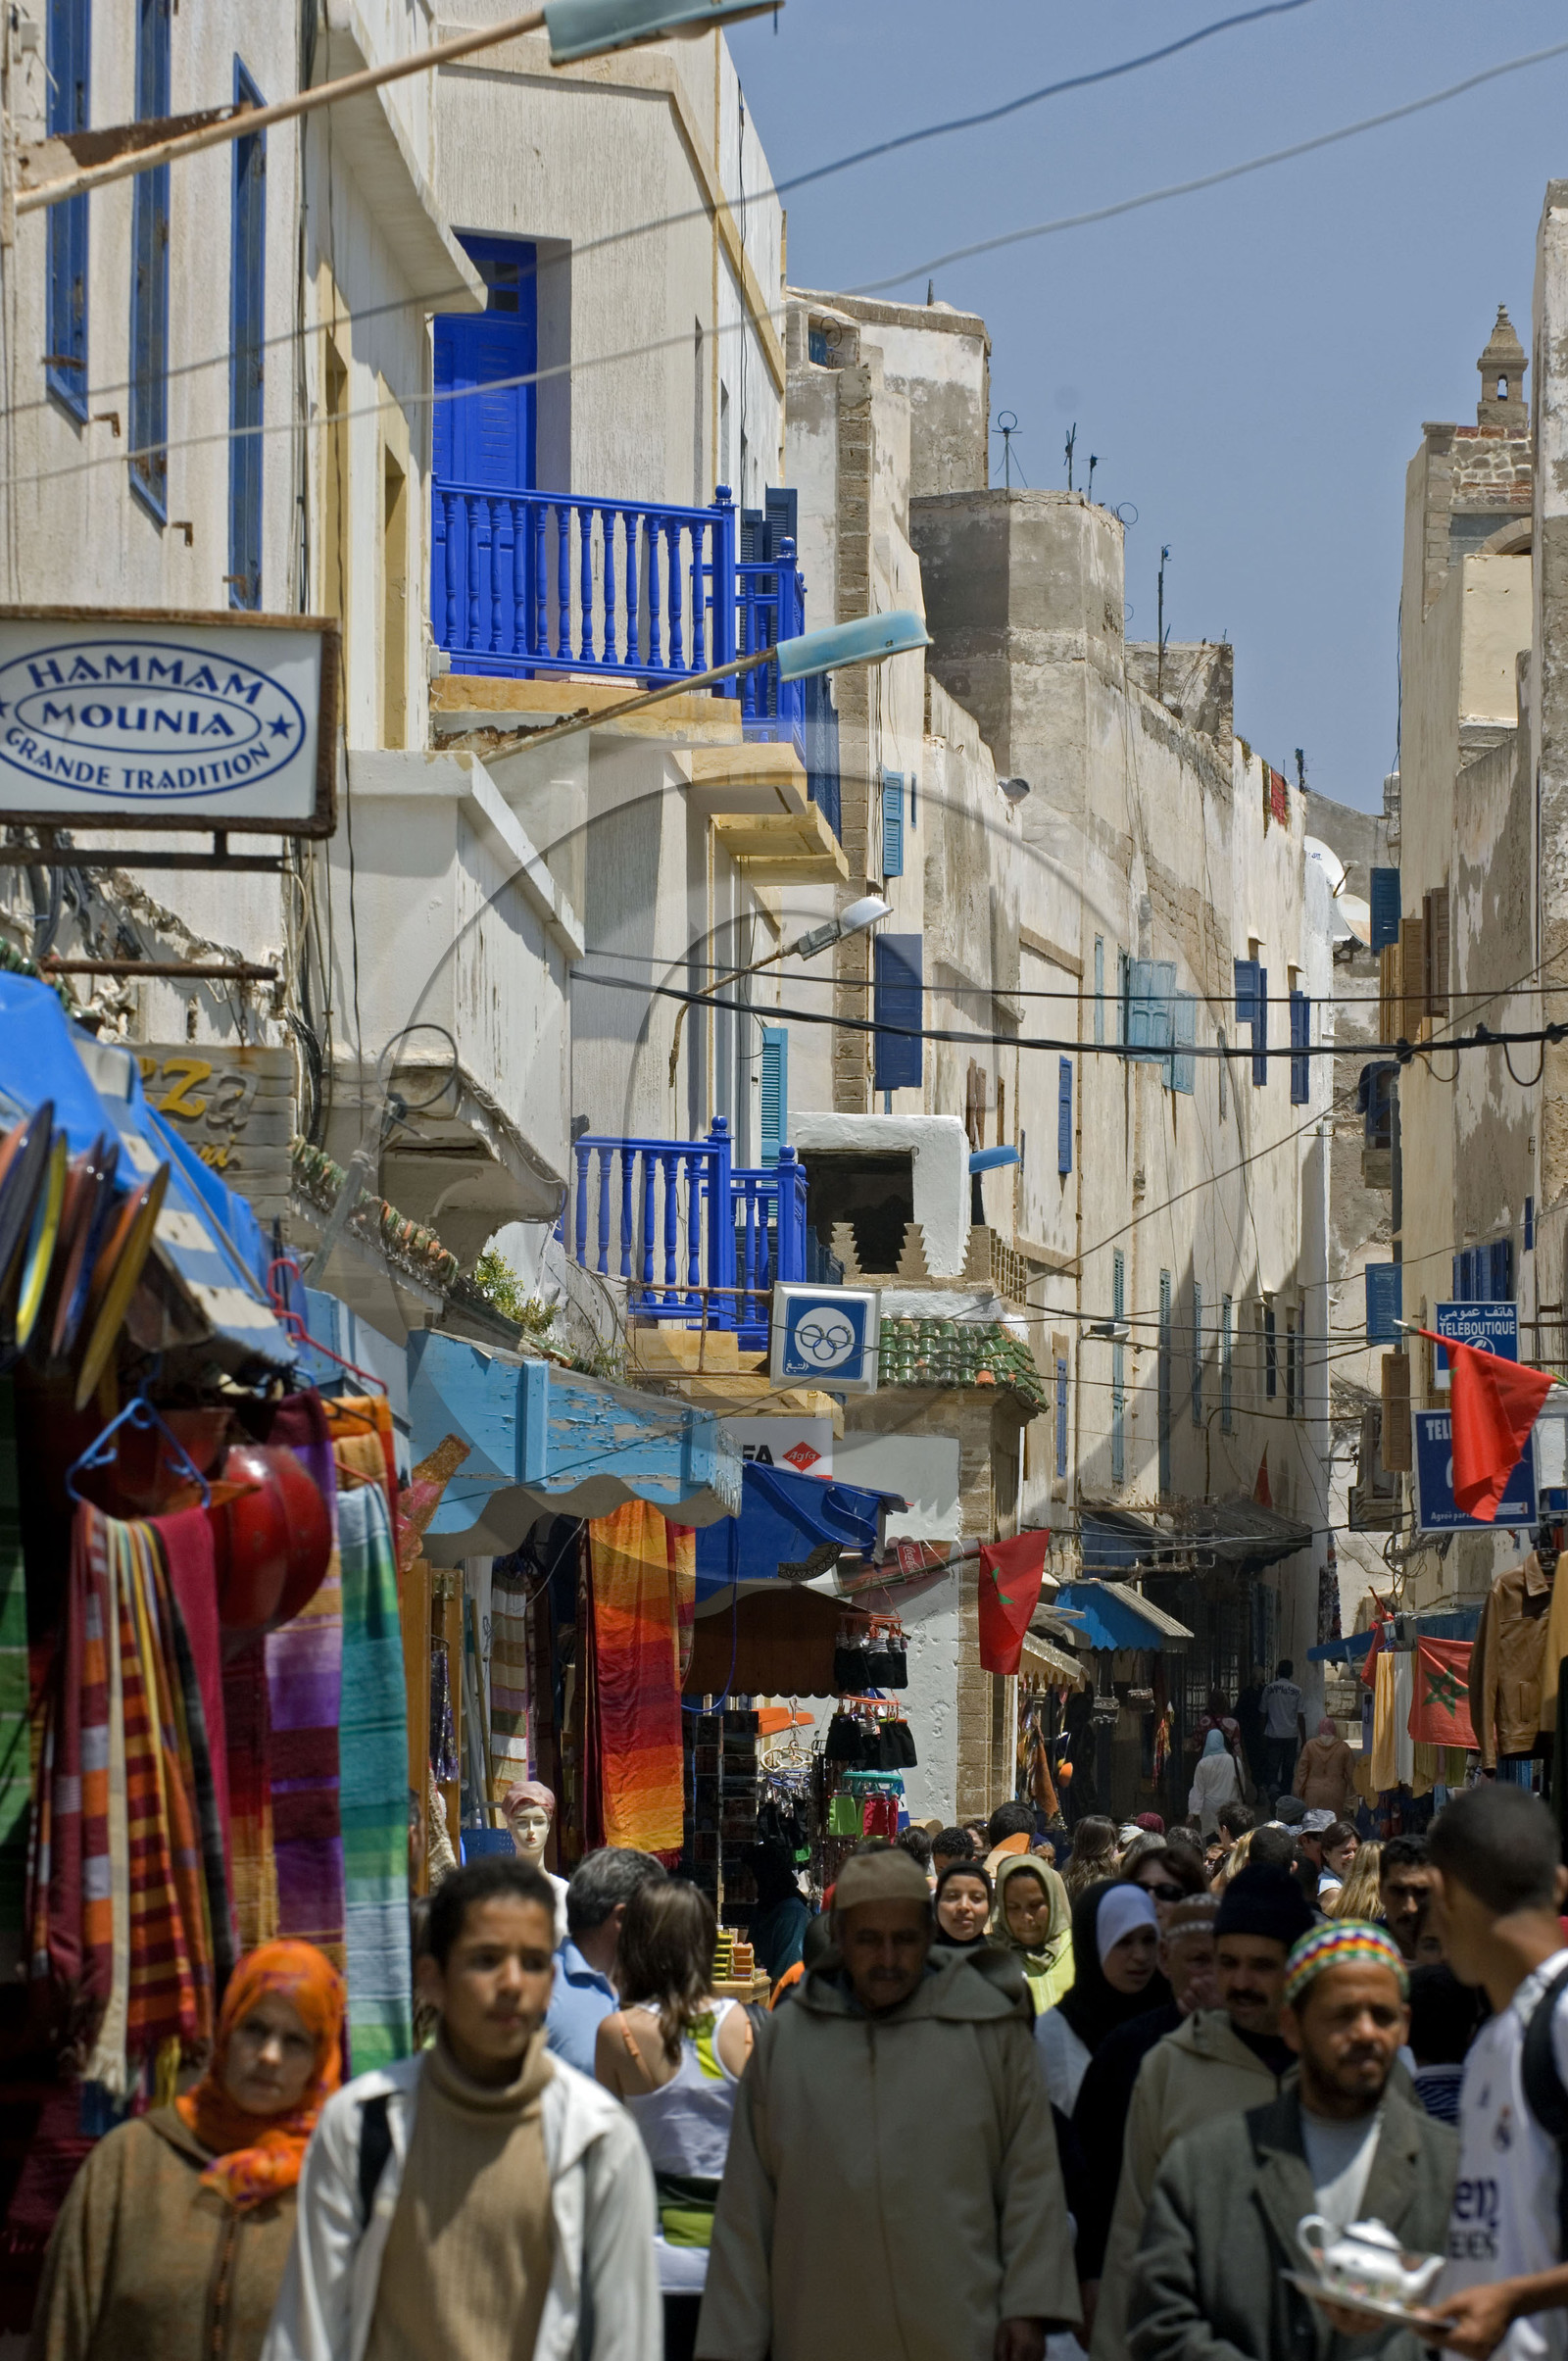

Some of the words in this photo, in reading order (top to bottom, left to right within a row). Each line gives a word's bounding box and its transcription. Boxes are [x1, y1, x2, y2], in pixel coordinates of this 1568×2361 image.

[27, 655, 264, 706] HAMMAM
[43, 701, 235, 737] MOUNIA
[5, 727, 112, 787] GRANDE
[122, 741, 270, 790] TRADITION
[1439, 1307, 1481, 1322] عمومي
[1484, 1305, 1515, 1317] هاتف
[1439, 1321, 1516, 1336] TELEBOUTIQUE
[787, 1451, 817, 1462] Agfa
